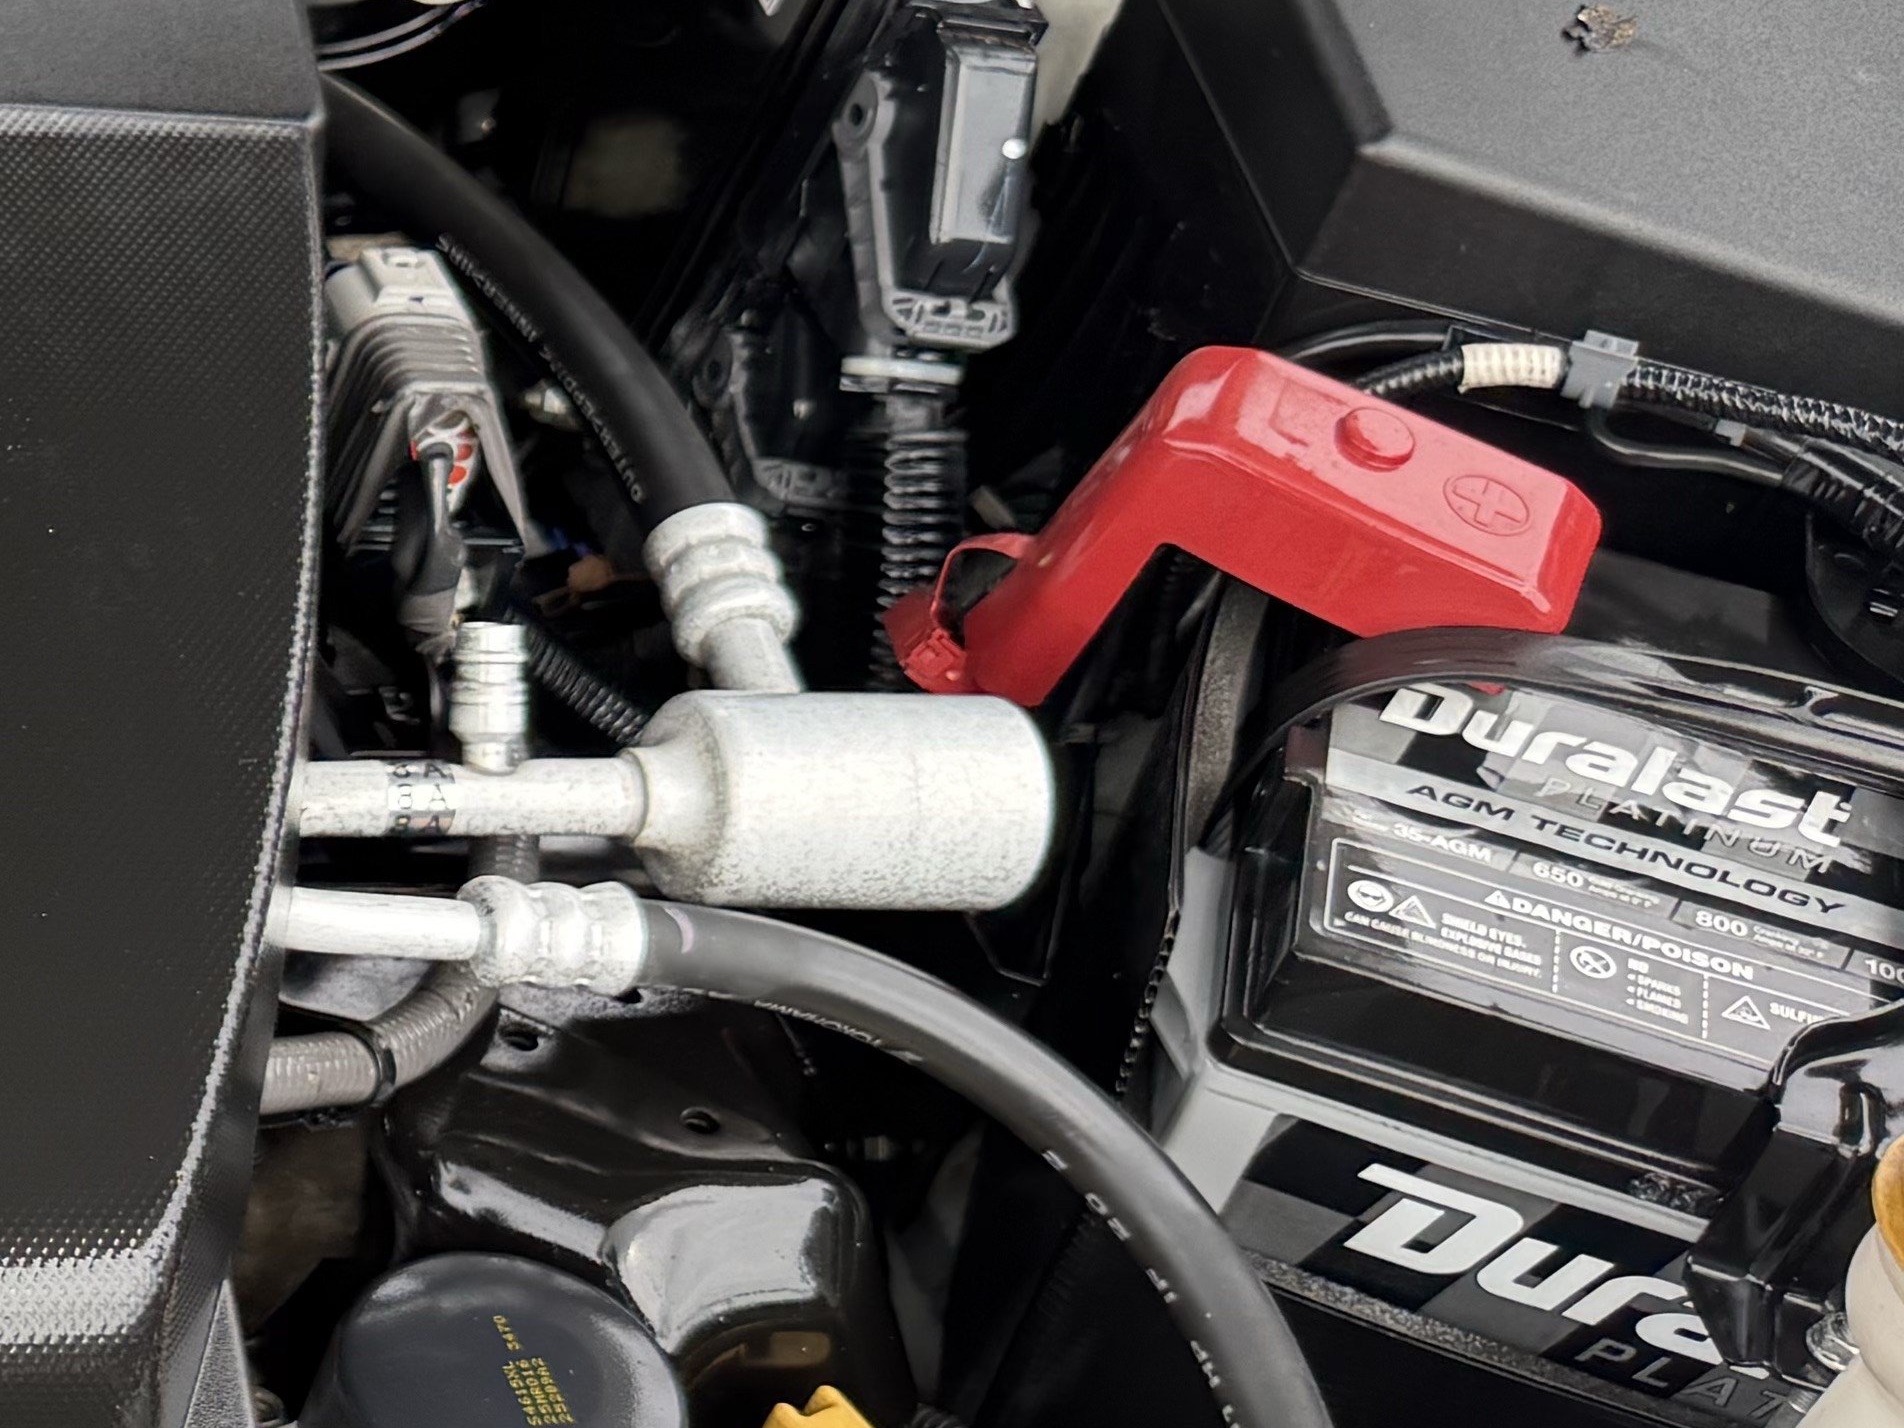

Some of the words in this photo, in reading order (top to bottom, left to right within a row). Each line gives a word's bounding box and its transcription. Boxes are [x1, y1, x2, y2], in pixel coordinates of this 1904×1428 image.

[1379, 682, 1852, 848] Duralast
[1393, 823, 1492, 864] 35-AGM
[1408, 785, 1515, 820] AGM
[1531, 815, 1845, 913] TECHNOLOGY
[1536, 777, 1833, 874] PLATINUM
[1532, 861, 1585, 888] 650
[1512, 897, 1754, 980] DANGER/POISON
[1695, 910, 1748, 937] 800
